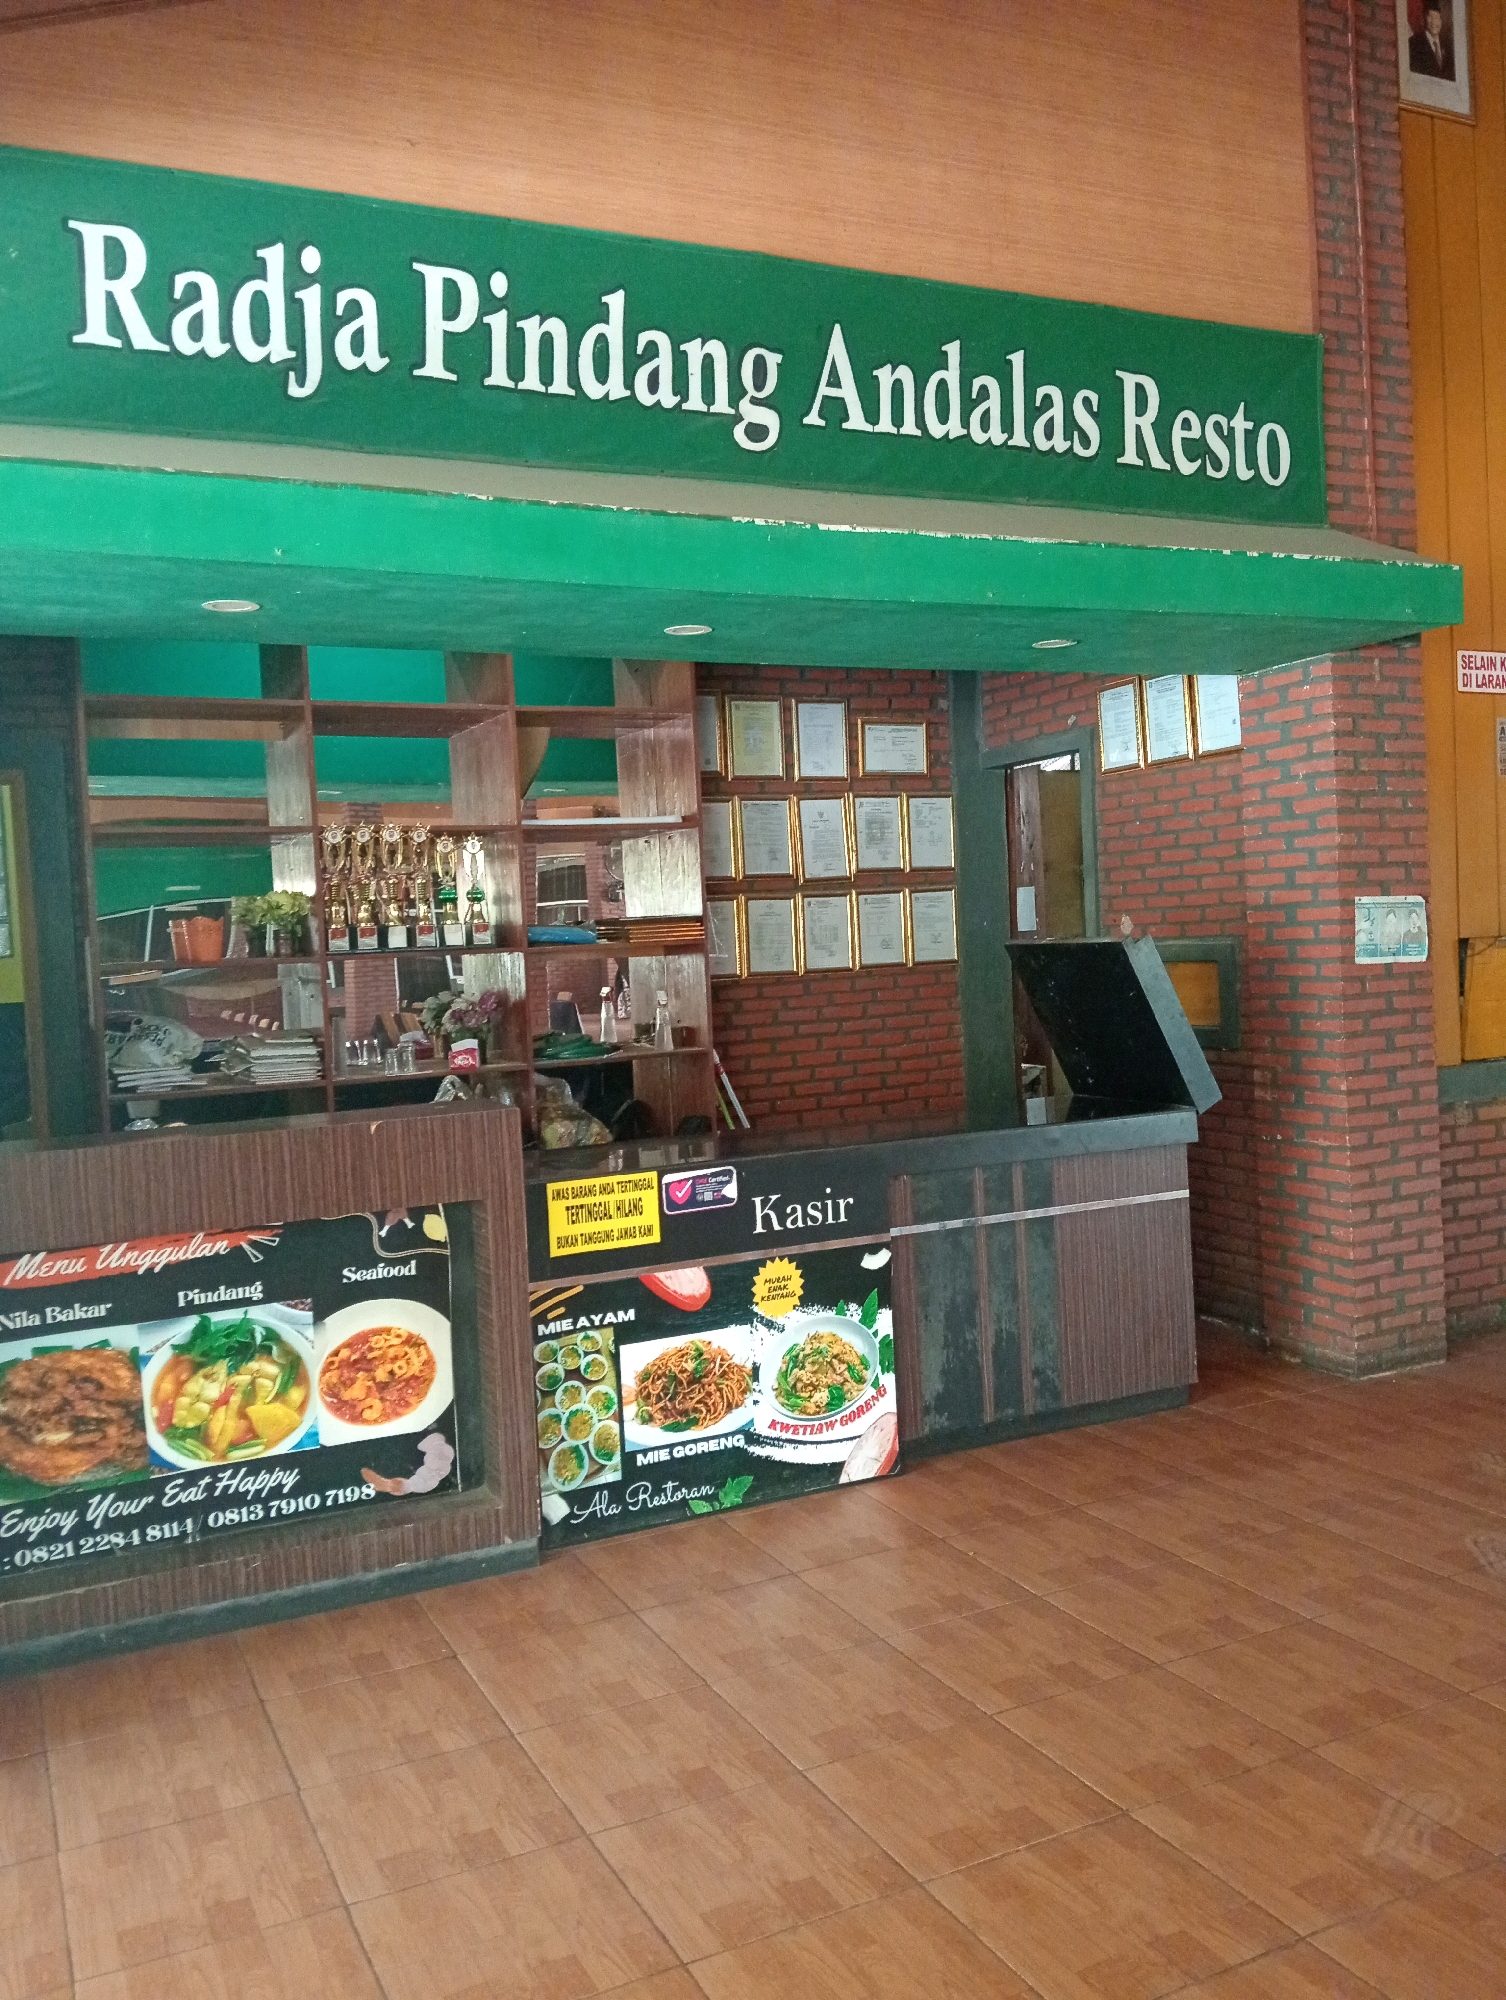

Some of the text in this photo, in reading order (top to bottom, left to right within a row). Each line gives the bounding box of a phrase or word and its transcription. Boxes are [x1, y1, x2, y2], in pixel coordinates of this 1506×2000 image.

[67, 218, 1292, 487] Radja Pindang Andalas Resto
[1461, 654, 1497, 671] SELAIN
[1462, 673, 1472, 688] DI
[551, 1177, 655, 1202] AWAS BARANG ANDA TERTINGGAL
[751, 1187, 854, 1235] Kasir
[556, 1223, 654, 1250] BUKAN TANGGUNG JAWAB KAMI
[3, 1231, 231, 1287] Menu Unggulan
[342, 1259, 417, 1284] Seafood
[177, 1281, 264, 1308] Pindang
[763, 1274, 793, 1287] MURAH
[767, 1283, 789, 1294] ENAK
[760, 1290, 797, 1303] KENYANG
[0, 1302, 113, 1331] Nila Bakar
[537, 1308, 635, 1337] MIE AYAM
[767, 1383, 888, 1436] KWETIAW GORENG
[636, 1434, 746, 1467] MIE GORENG
[0, 1466, 301, 1543] Enjoy Your Eat Happy
[569, 1481, 715, 1524] Ala Restoran
[14, 1540, 76, 1567] 0821
[79, 1528, 142, 1555] 2284
[145, 1517, 194, 1543] 8114
[207, 1502, 265, 1528] 0813
[267, 1492, 321, 1518] 7910
[324, 1482, 377, 1507] 7198
